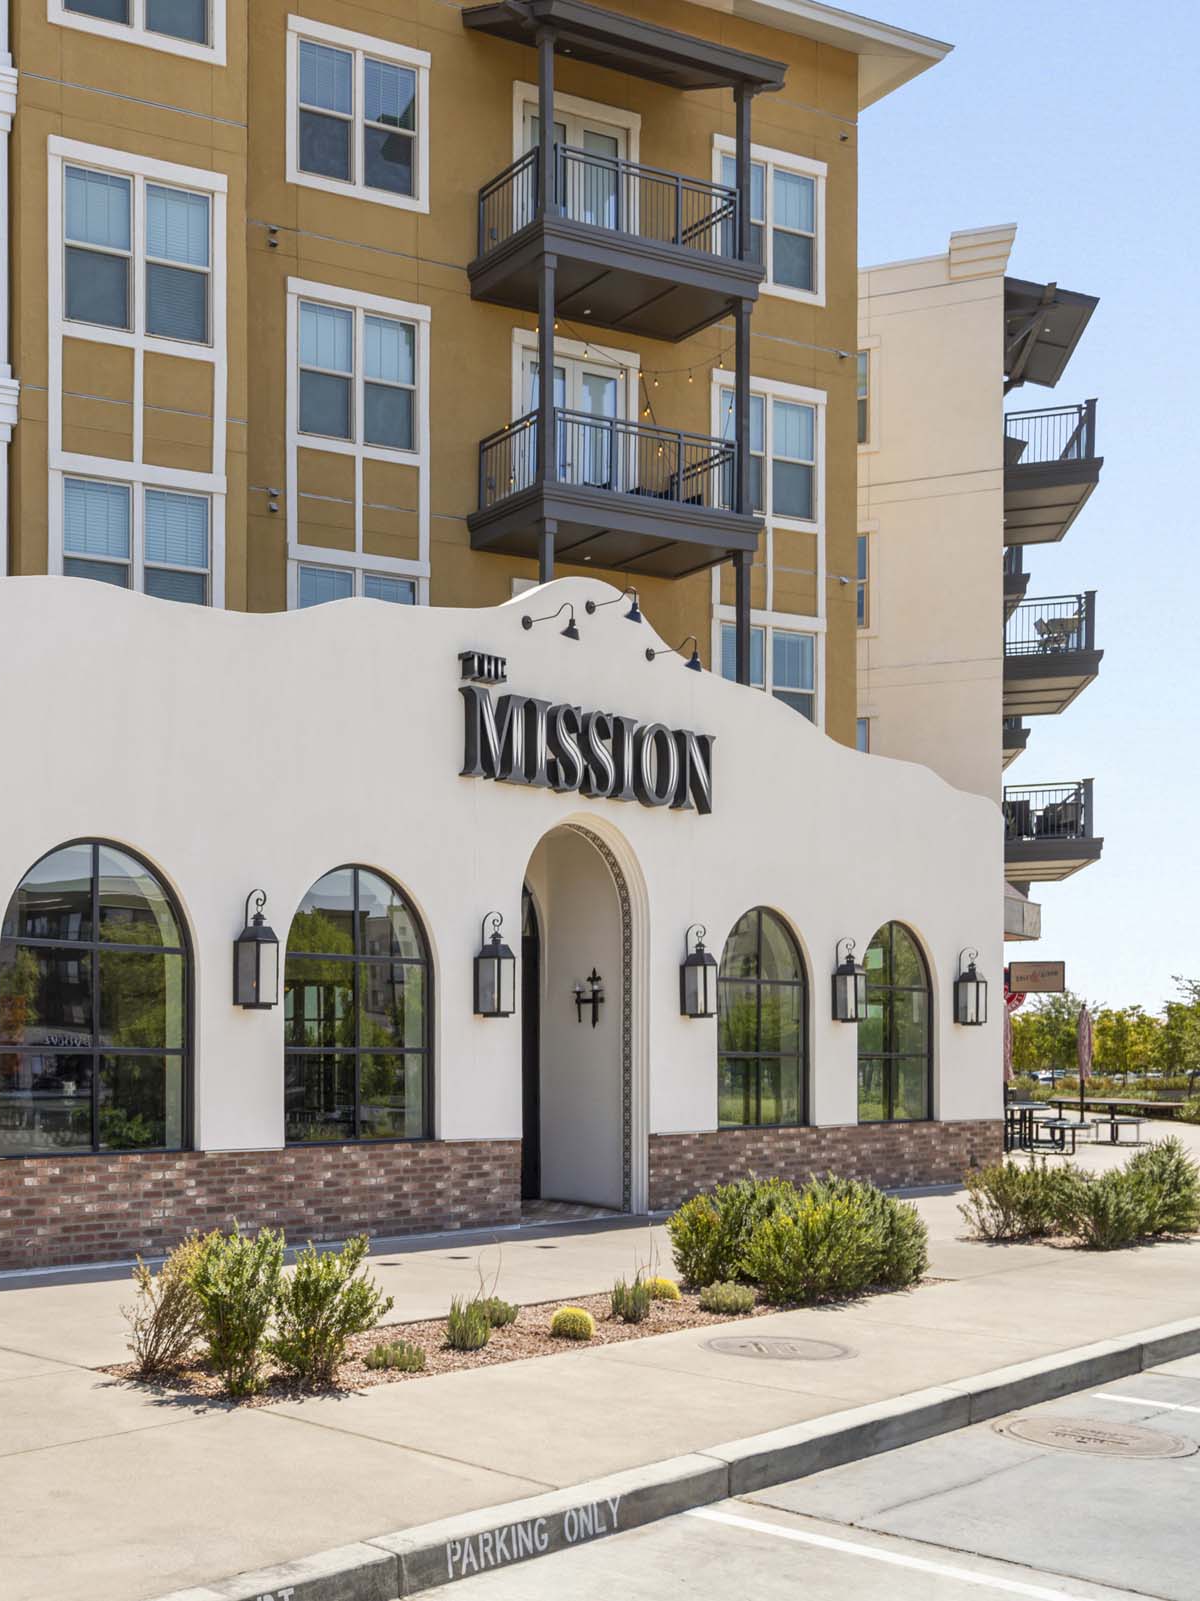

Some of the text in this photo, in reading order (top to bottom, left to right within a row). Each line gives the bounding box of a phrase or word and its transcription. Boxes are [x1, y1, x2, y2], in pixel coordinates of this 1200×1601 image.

[458, 651, 507, 683] THE
[458, 686, 716, 815] MISSION
[446, 1496, 621, 1578] PARKING ONLY
